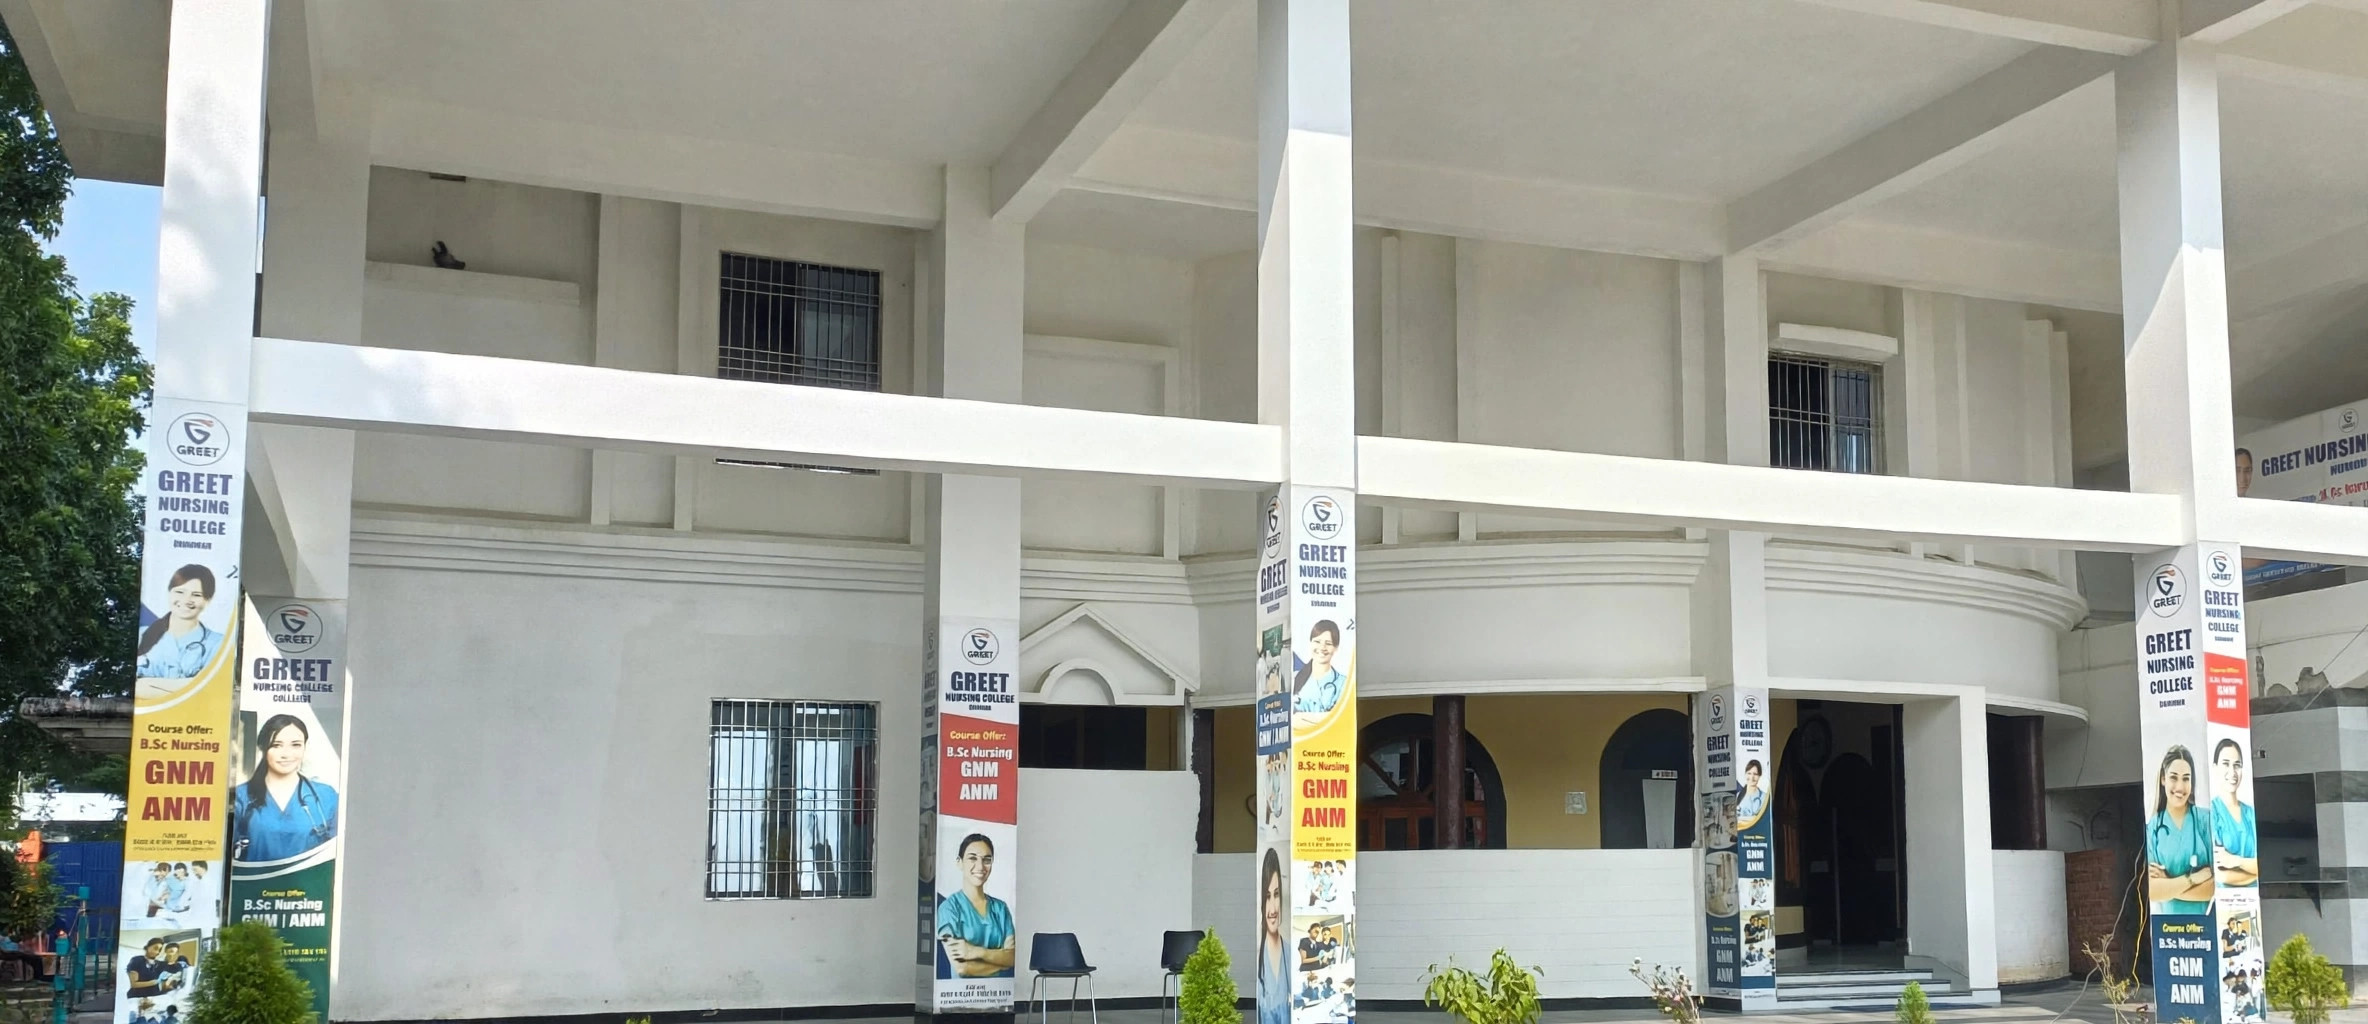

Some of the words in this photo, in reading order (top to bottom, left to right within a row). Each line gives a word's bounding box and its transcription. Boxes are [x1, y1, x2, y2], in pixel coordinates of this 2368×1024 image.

[177, 446, 220, 458] GREET
[2262, 450, 2301, 477] GREET
[2305, 433, 2368, 466] NURSIN
[159, 470, 232, 495] GREET
[158, 498, 229, 515] NURSING
[161, 518, 226, 535] COLLEGE
[1309, 523, 1337, 532] GREET
[1299, 544, 1347, 562] GREET
[1261, 559, 1287, 593] GREET
[1299, 565, 1347, 579] NURSING
[1302, 583, 1345, 595] COLLEGE
[2154, 595, 2181, 609] GREET
[2205, 590, 2239, 606] GREET
[2205, 608, 2240, 620] NURSING
[2208, 622, 2239, 633] COLLEGE
[275, 634, 314, 644] GREET
[2146, 629, 2192, 655] GREET
[968, 651, 993, 659] GREET
[254, 658, 332, 681] GREET
[2147, 655, 2194, 674] NURSING
[951, 671, 1009, 692] GREET
[2150, 677, 2193, 694] COLLEGE
[946, 692, 980, 702] NURSING
[983, 693, 1014, 703] COLLEGE
[148, 725, 183, 734] Course
[186, 725, 213, 735] Offer:
[1740, 720, 1764, 730] GREET
[950, 731, 980, 740] Course
[983, 731, 1006, 740] Offer:
[1707, 734, 1729, 751] GREET
[140, 739, 167, 750] B.Sc
[171, 739, 219, 752] Nursing
[947, 747, 969, 757] B.Sc
[971, 746, 1013, 760] Nursing
[145, 761, 214, 785] GNM
[961, 762, 998, 778] GNM
[960, 784, 998, 801] ANM
[1303, 779, 1347, 798] GNM
[142, 797, 210, 821] ANM
[1302, 807, 1346, 827] ANM
[244, 900, 271, 910] B.Sc
[275, 898, 322, 911] Nursing
[289, 913, 325, 927] ANM
[2159, 938, 2177, 949] B.Sc
[2179, 937, 2211, 951] Nursing
[2169, 957, 2203, 977] GNM
[2171, 985, 2204, 1004] ANM
